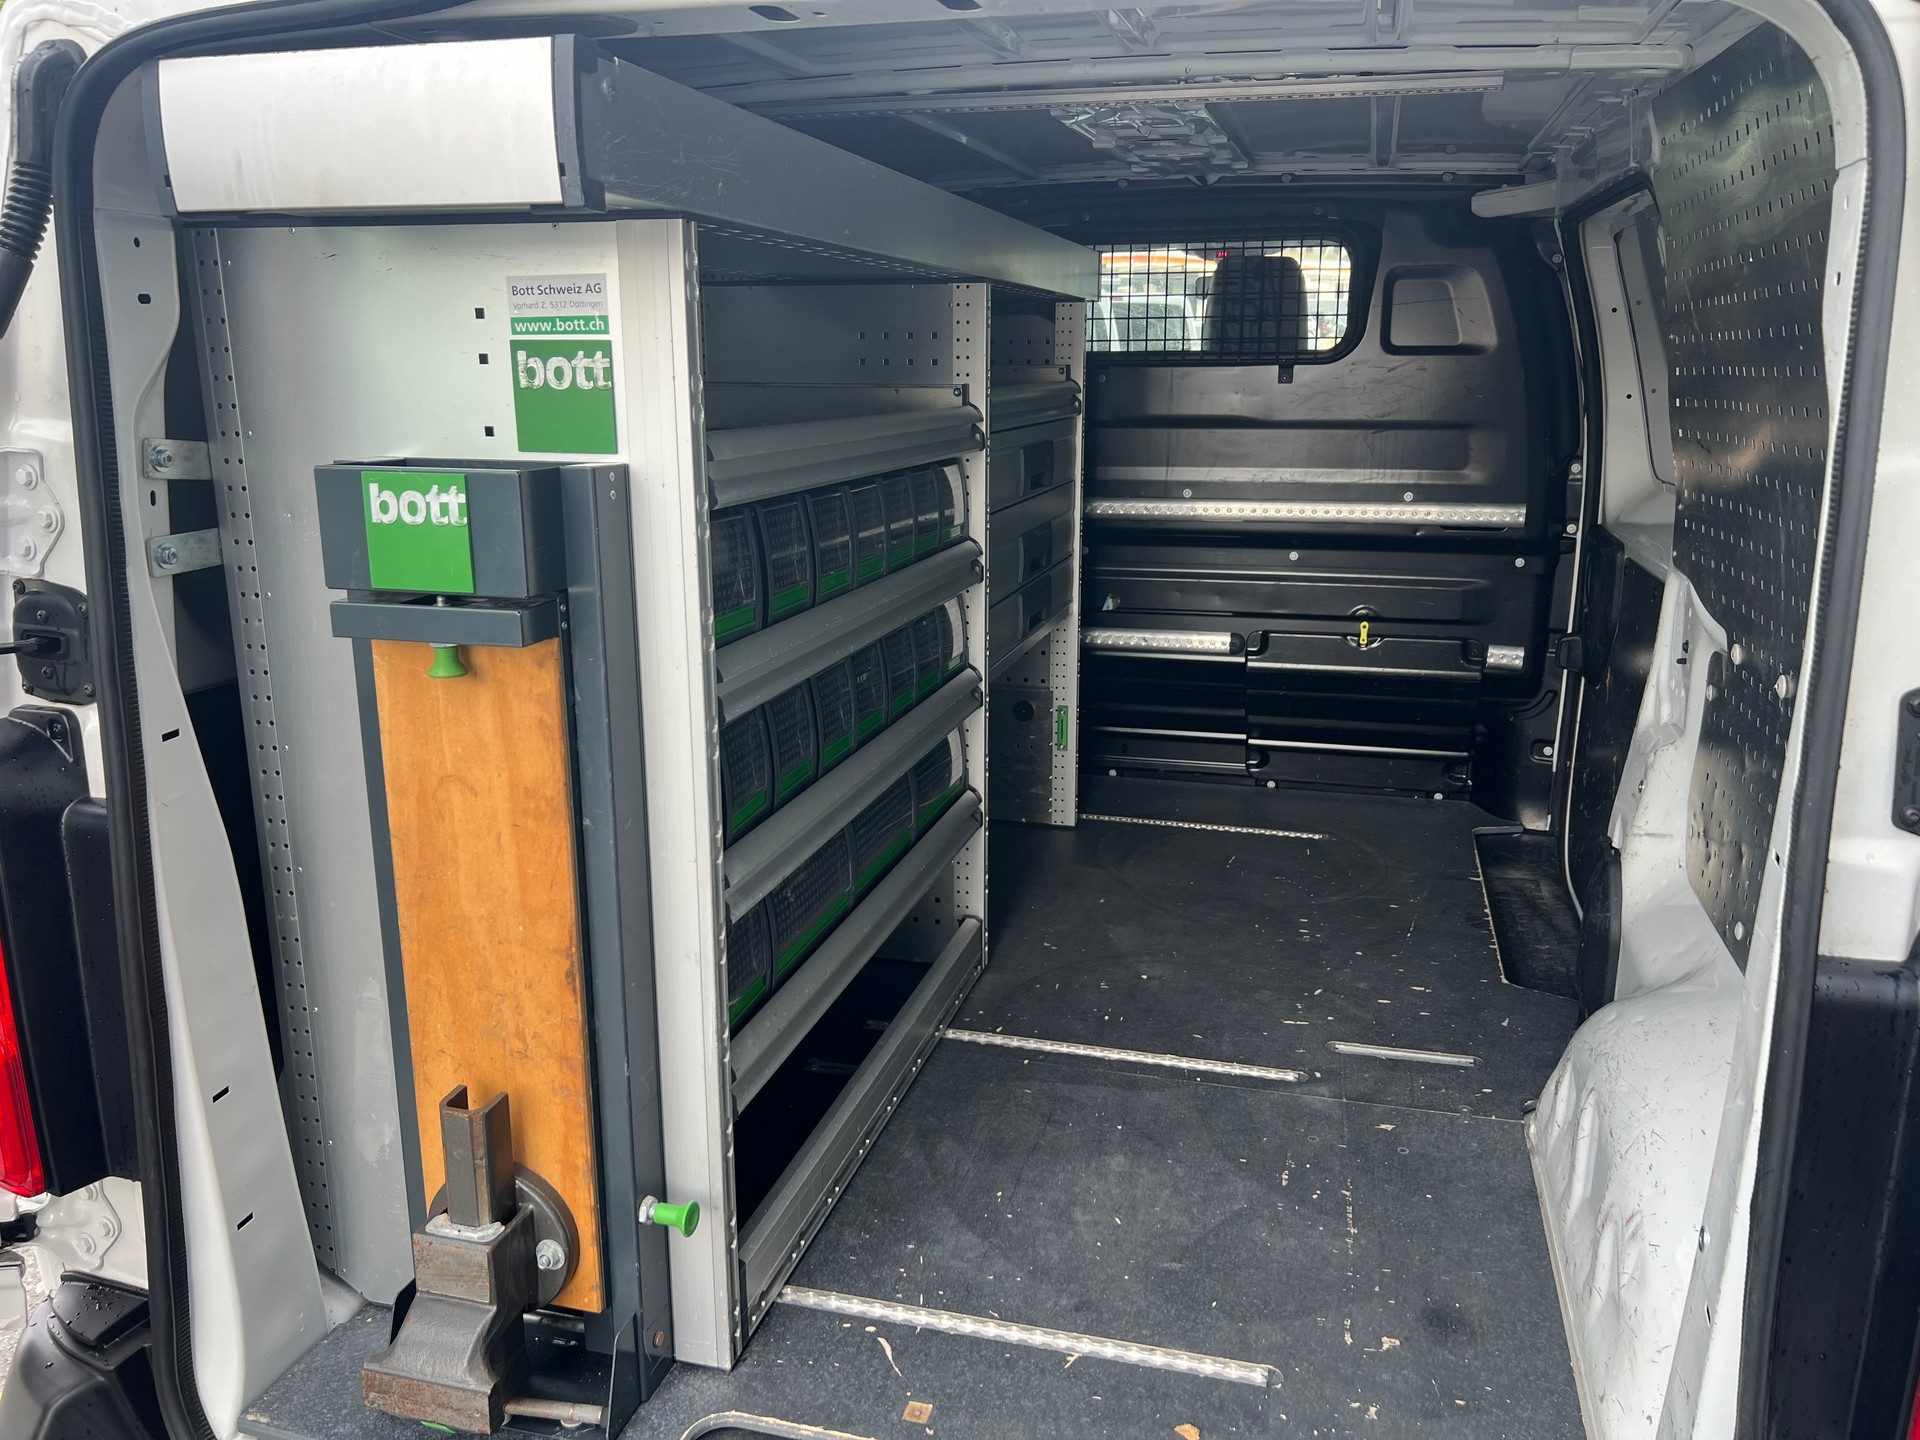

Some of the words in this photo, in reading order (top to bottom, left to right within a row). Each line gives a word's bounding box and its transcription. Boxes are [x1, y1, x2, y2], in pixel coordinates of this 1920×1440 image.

[511, 285, 535, 296] Bott
[537, 283, 582, 296] Schweiz
[585, 283, 602, 294] AG
[512, 302, 539, 310] Vorhard
[541, 301, 548, 309] 2,
[550, 300, 567, 308] 5312
[570, 300, 604, 310] Döttingen
[514, 317, 605, 332] www.bott.ch
[516, 350, 612, 390] bott
[368, 483, 468, 527] bott
